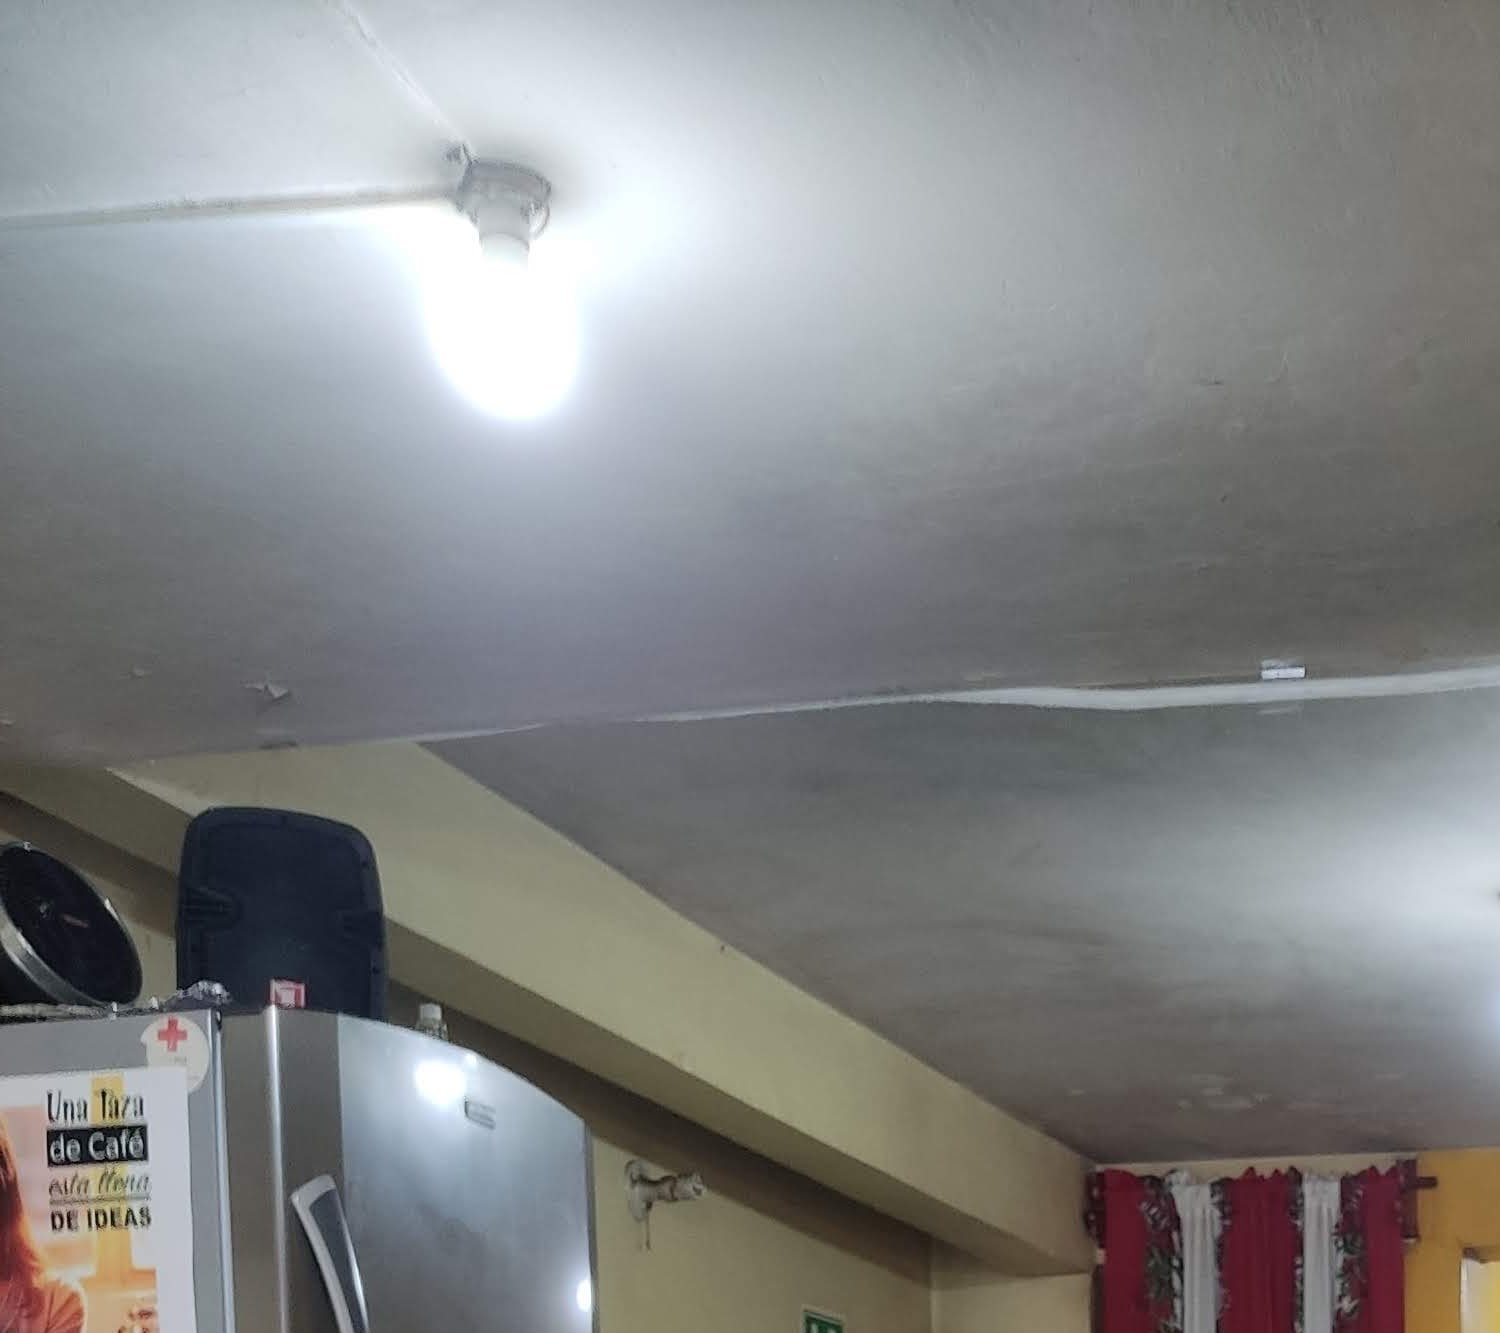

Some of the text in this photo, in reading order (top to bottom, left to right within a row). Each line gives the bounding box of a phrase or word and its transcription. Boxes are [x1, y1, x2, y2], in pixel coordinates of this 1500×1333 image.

[47, 1090, 88, 1122] Una
[50, 1129, 144, 1163] de Café
[50, 1206, 151, 1231] DE IDEAS
